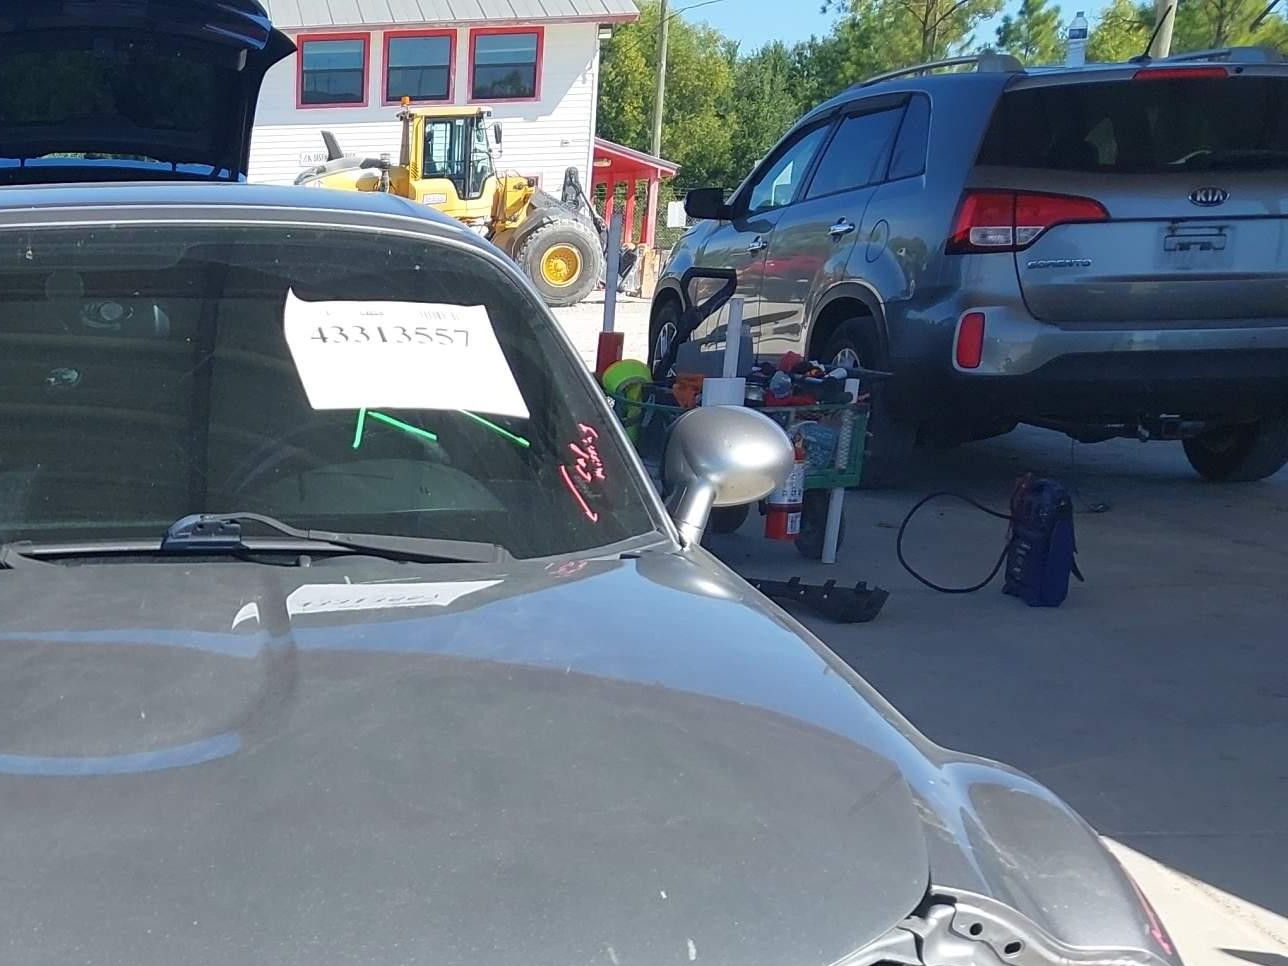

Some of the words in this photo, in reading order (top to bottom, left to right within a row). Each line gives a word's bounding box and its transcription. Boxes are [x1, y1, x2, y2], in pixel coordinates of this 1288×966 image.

[1195, 190, 1223, 202] KIA
[1027, 258, 1093, 269] SORENTO
[310, 325, 469, 347] 43313557
